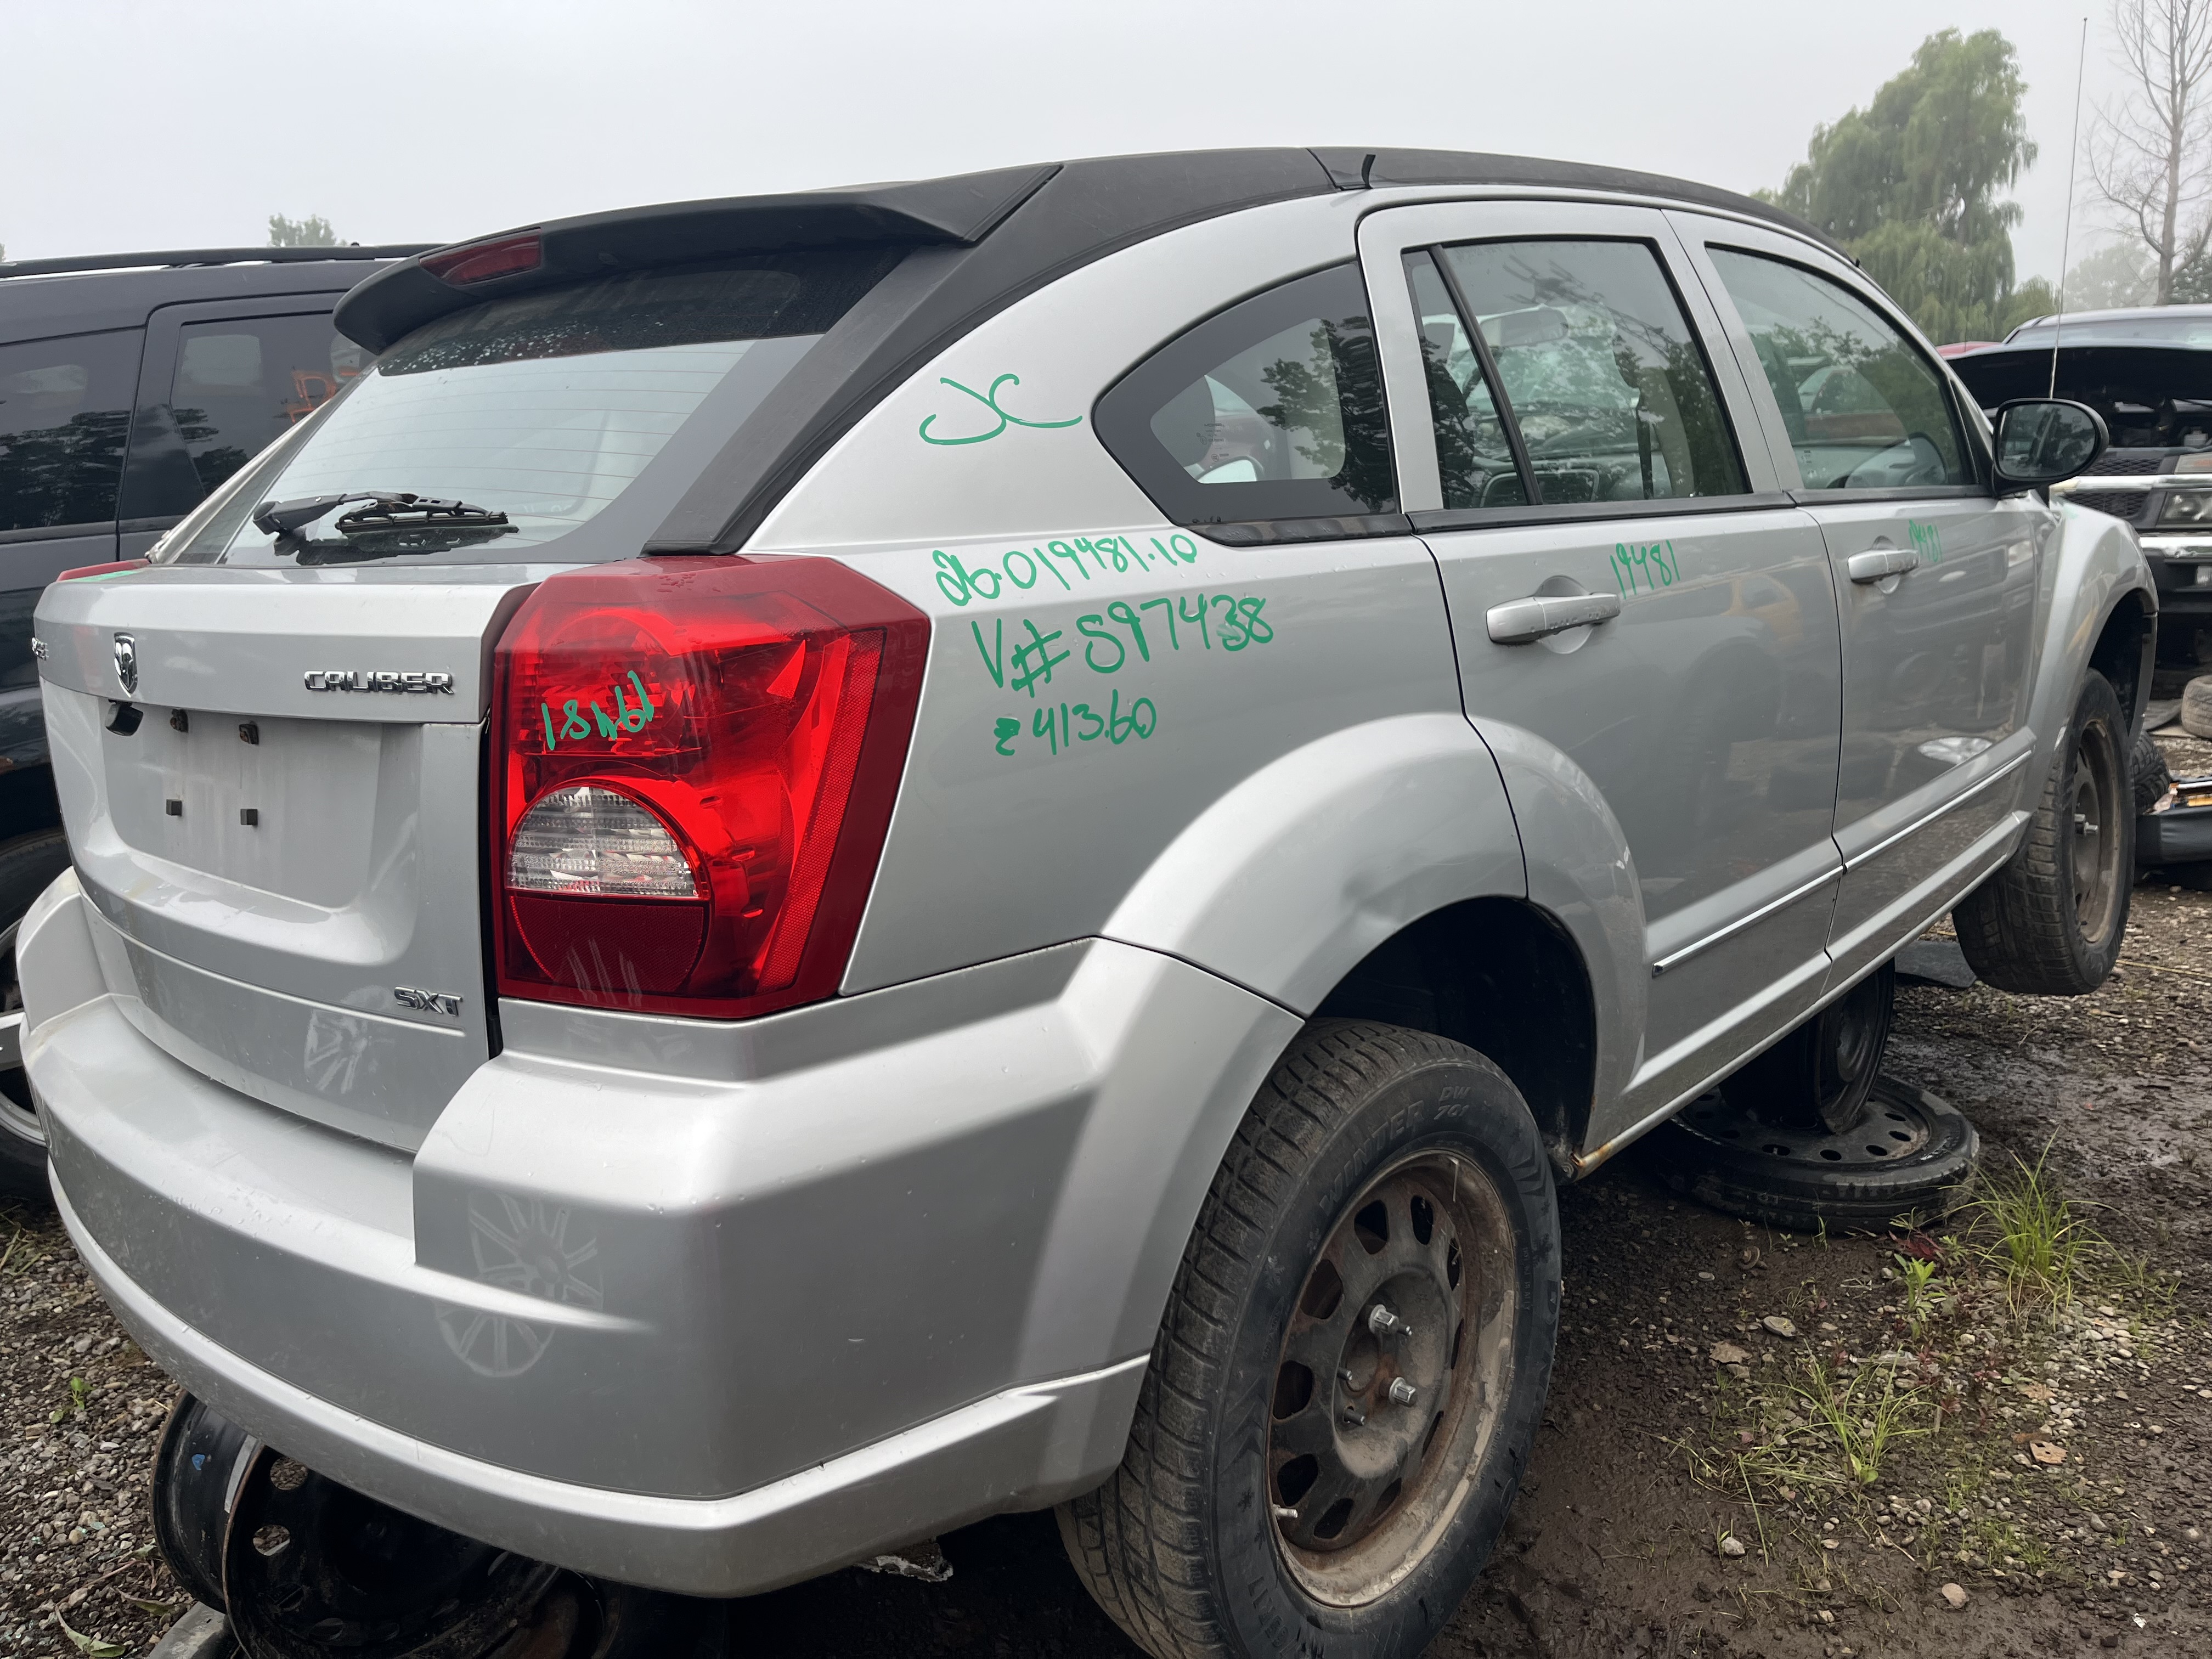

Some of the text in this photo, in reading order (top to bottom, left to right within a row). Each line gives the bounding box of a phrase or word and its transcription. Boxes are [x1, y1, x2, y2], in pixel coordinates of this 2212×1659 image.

[1610, 540, 1681, 599] 19481
[304, 671, 455, 695] CALIBER
[394, 986, 462, 1017] SXT
[1438, 1086, 1471, 1102] DW
[1433, 1104, 1470, 1120] 701
[1318, 1099, 1425, 1217] WINTER
